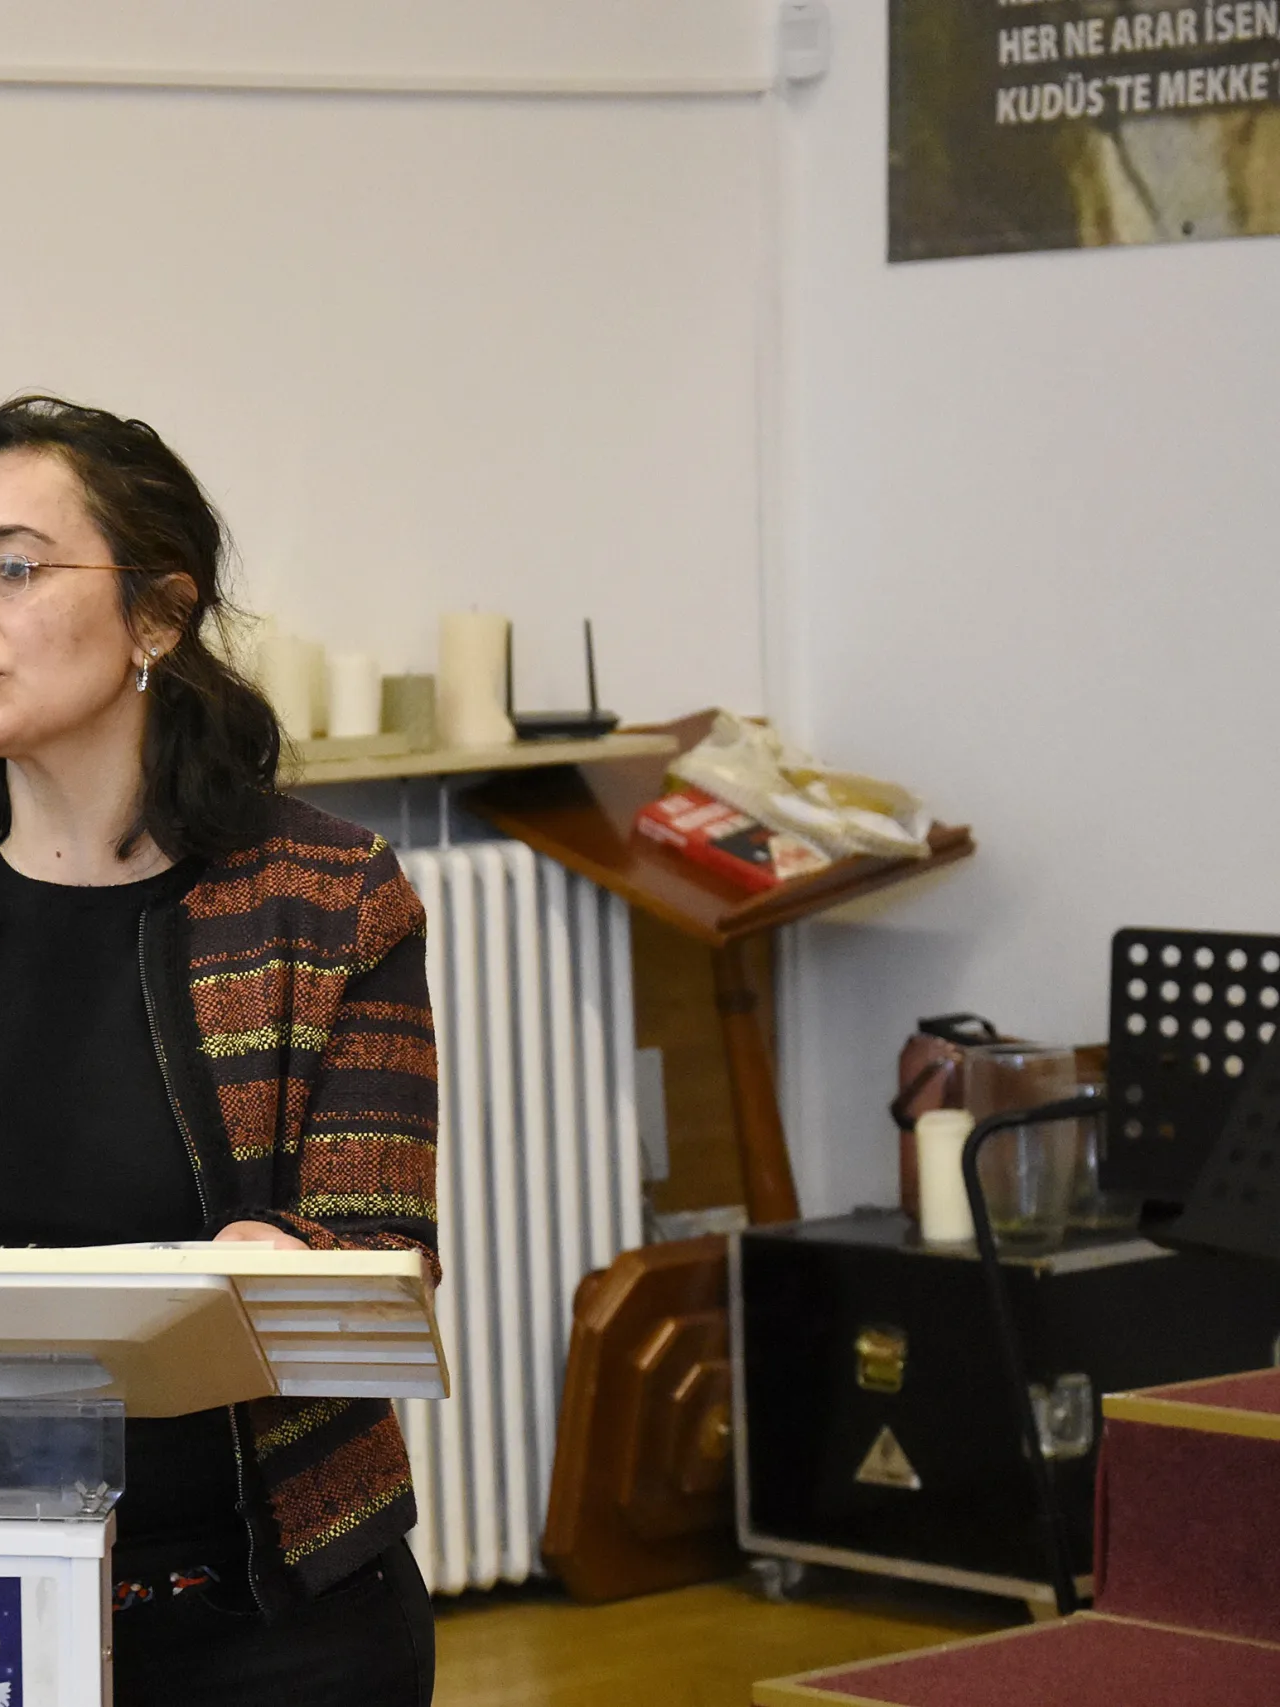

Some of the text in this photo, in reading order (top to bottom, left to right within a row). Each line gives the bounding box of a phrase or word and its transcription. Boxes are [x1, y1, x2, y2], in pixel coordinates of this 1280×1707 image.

[998, 25, 1059, 65] HER
[1064, 19, 1104, 57] NE
[1110, 8, 1198, 53] ARAR
[1158, 60, 1280, 109] MEKKE'
